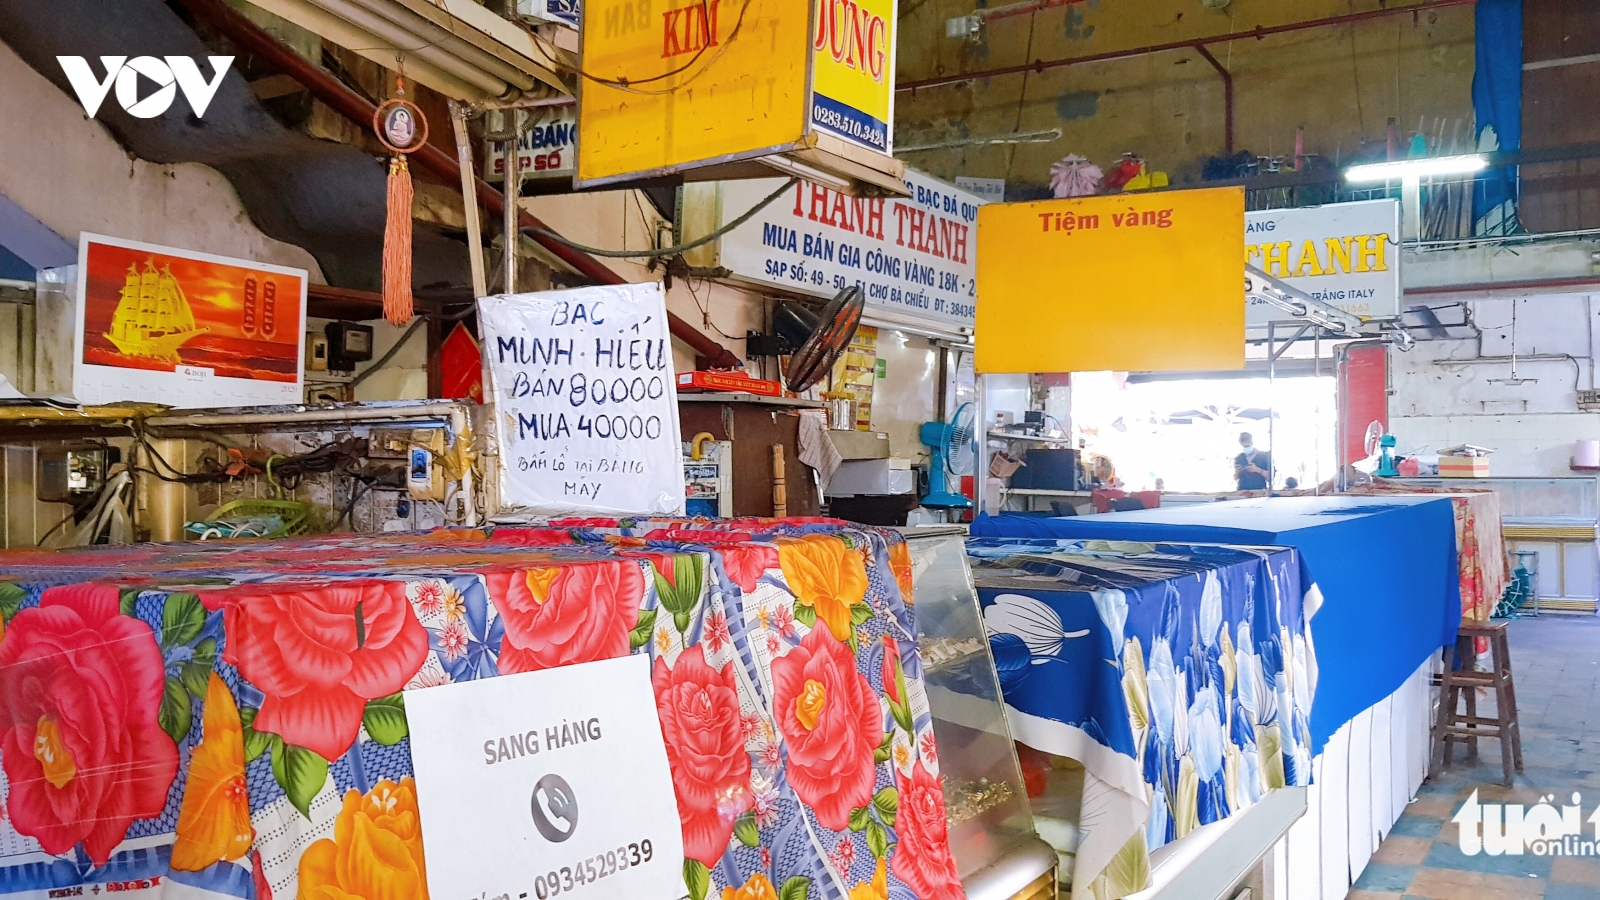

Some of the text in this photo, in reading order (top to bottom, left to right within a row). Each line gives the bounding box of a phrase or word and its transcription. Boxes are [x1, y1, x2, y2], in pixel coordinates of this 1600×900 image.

[661, 0, 720, 58] KIM
[494, 148, 562, 174] SP SỐ
[917, 185, 940, 210] BẠC
[943, 194, 957, 216] ĐÁ
[793, 178, 968, 265] THANH THANH
[1038, 207, 1173, 236] Tiệm vàng
[1246, 219, 1276, 234] ÀNG
[762, 222, 798, 253] MUA
[803, 231, 834, 262] BÁN
[838, 243, 861, 269] GIA
[865, 247, 900, 279] CÔNG
[904, 258, 935, 287] VÀNG
[938, 270, 959, 294] 18K
[968, 278, 976, 297] 2
[1245, 233, 1388, 278] THANH
[765, 259, 787, 280] SẠP
[790, 260, 807, 283] SỐ:
[811, 269, 824, 286] 49
[833, 274, 846, 291] 50
[869, 283, 889, 304] CHỢ
[890, 286, 902, 304] BÀ
[904, 288, 929, 310] CHIỂU
[1348, 288, 1375, 299] ITALY
[551, 300, 605, 332] BẠC
[595, 316, 667, 371] HIẾU
[511, 369, 664, 407] BÁN 80000
[518, 412, 662, 441] MUA 40000
[483, 717, 602, 765] SANG HÀNG
[534, 838, 654, 900] 0934529339
